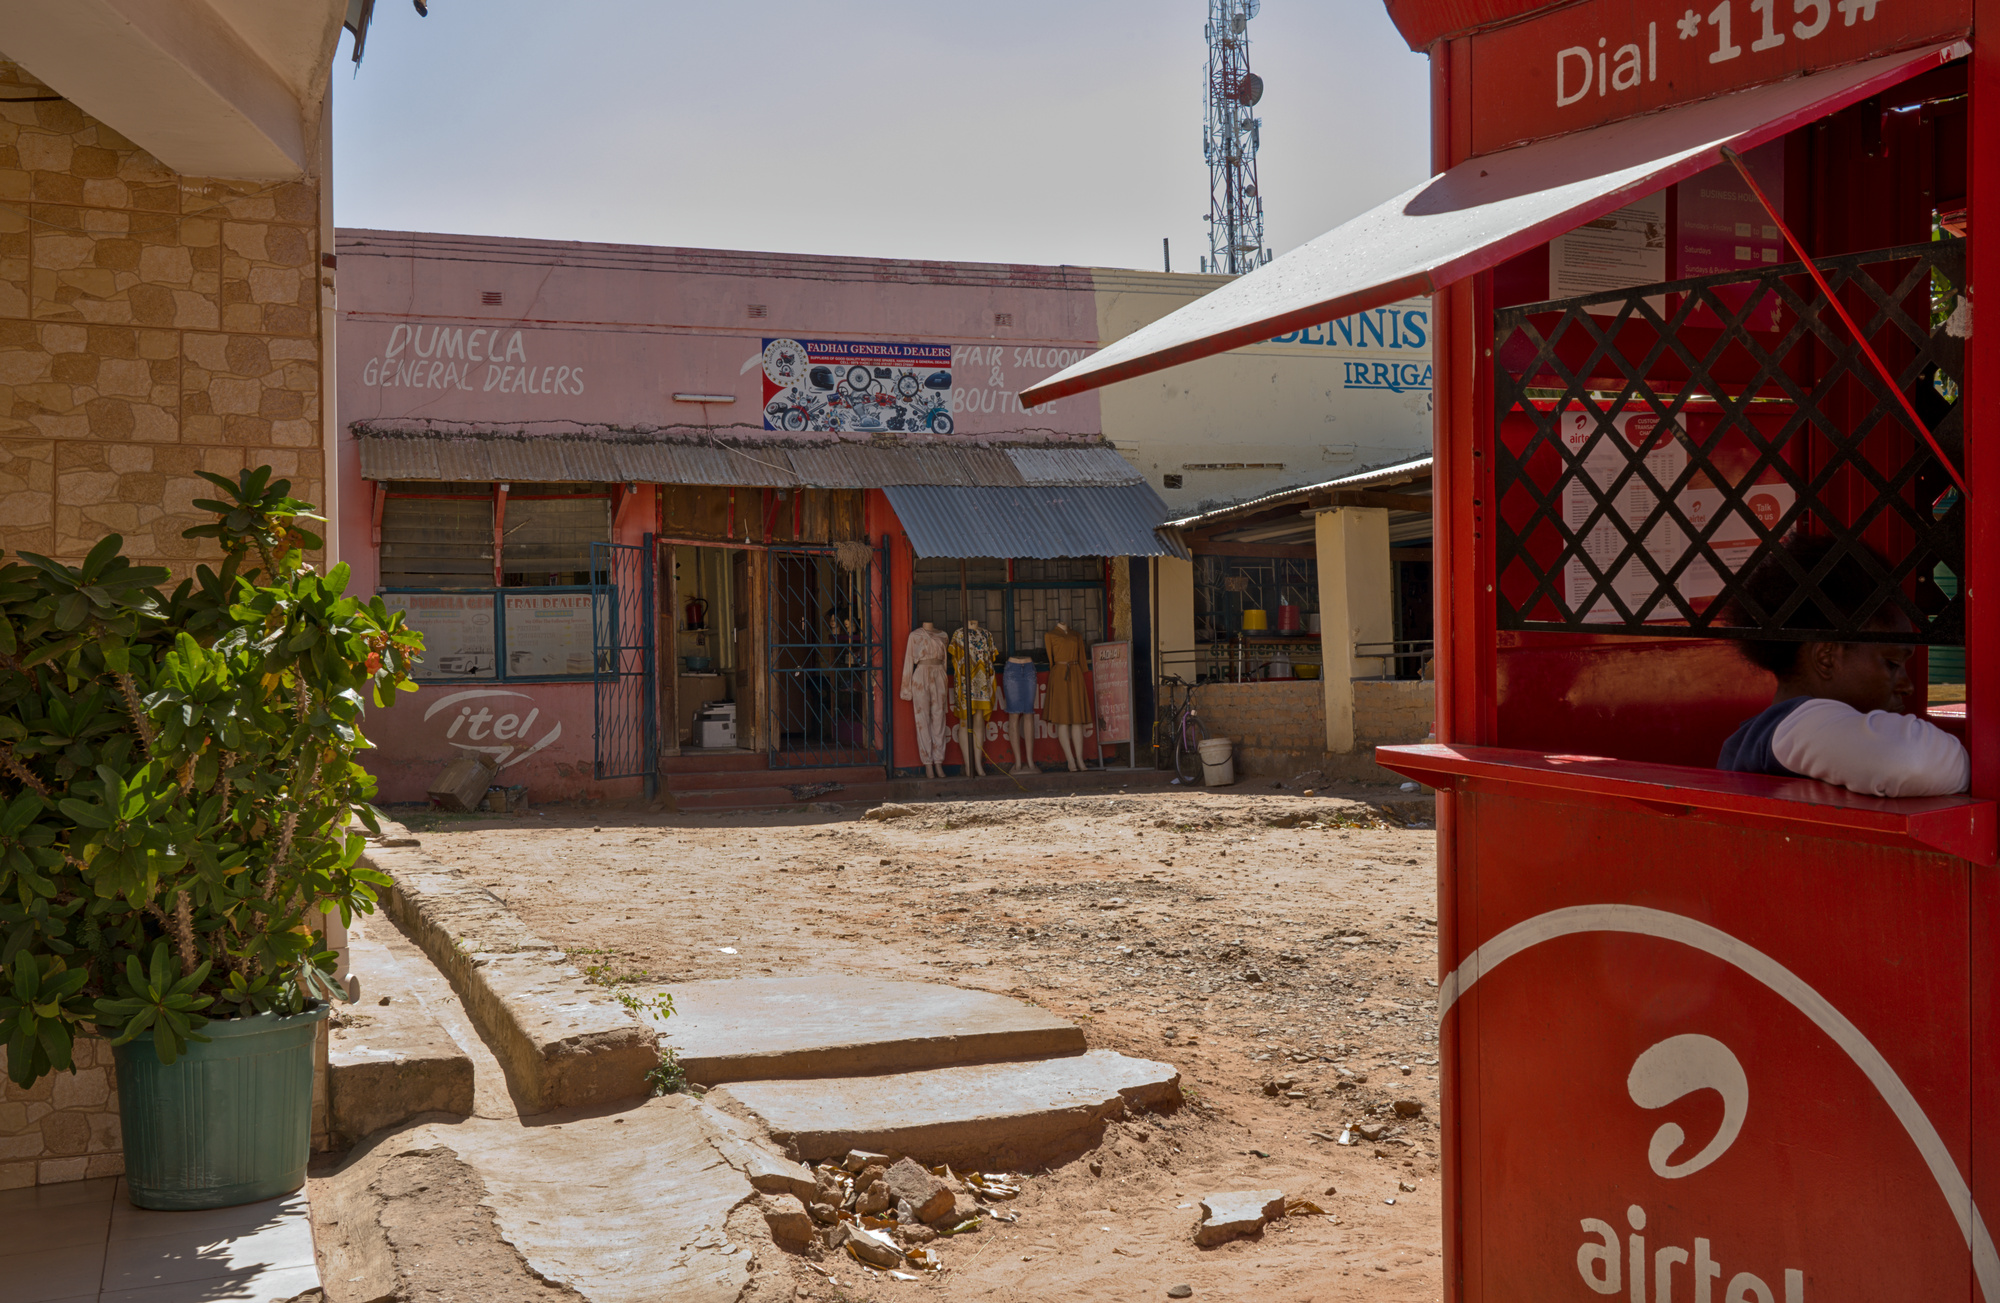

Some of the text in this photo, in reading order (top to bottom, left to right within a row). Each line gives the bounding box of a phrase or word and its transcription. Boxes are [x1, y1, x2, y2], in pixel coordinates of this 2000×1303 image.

[1556, 21, 1657, 108] Dial
[1700, 188, 1761, 203] BUSINESS HOUR
[1684, 221, 1709, 231] Mondays
[1713, 223, 1732, 232] Fridays
[1753, 228, 1760, 236] to
[1684, 245, 1712, 255] Saturdays
[1753, 251, 1760, 259] to
[1685, 264, 1708, 274] Sundays
[386, 323, 526, 363] DUMELA
[807, 342, 951, 358] FADHAI GENERAL DEALERS
[951, 346, 1004, 367] HAIR
[363, 357, 585, 396] GENERAL DEALERS
[988, 366, 1004, 388] &
[1569, 433, 1592, 444] airte
[1757, 503, 1772, 512] Talk
[1689, 514, 1706, 523] airtel
[1764, 512, 1774, 521] us
[410, 597, 464, 609] DUMELA
[506, 598, 539, 609] ERAL
[446, 707, 539, 741] itel
